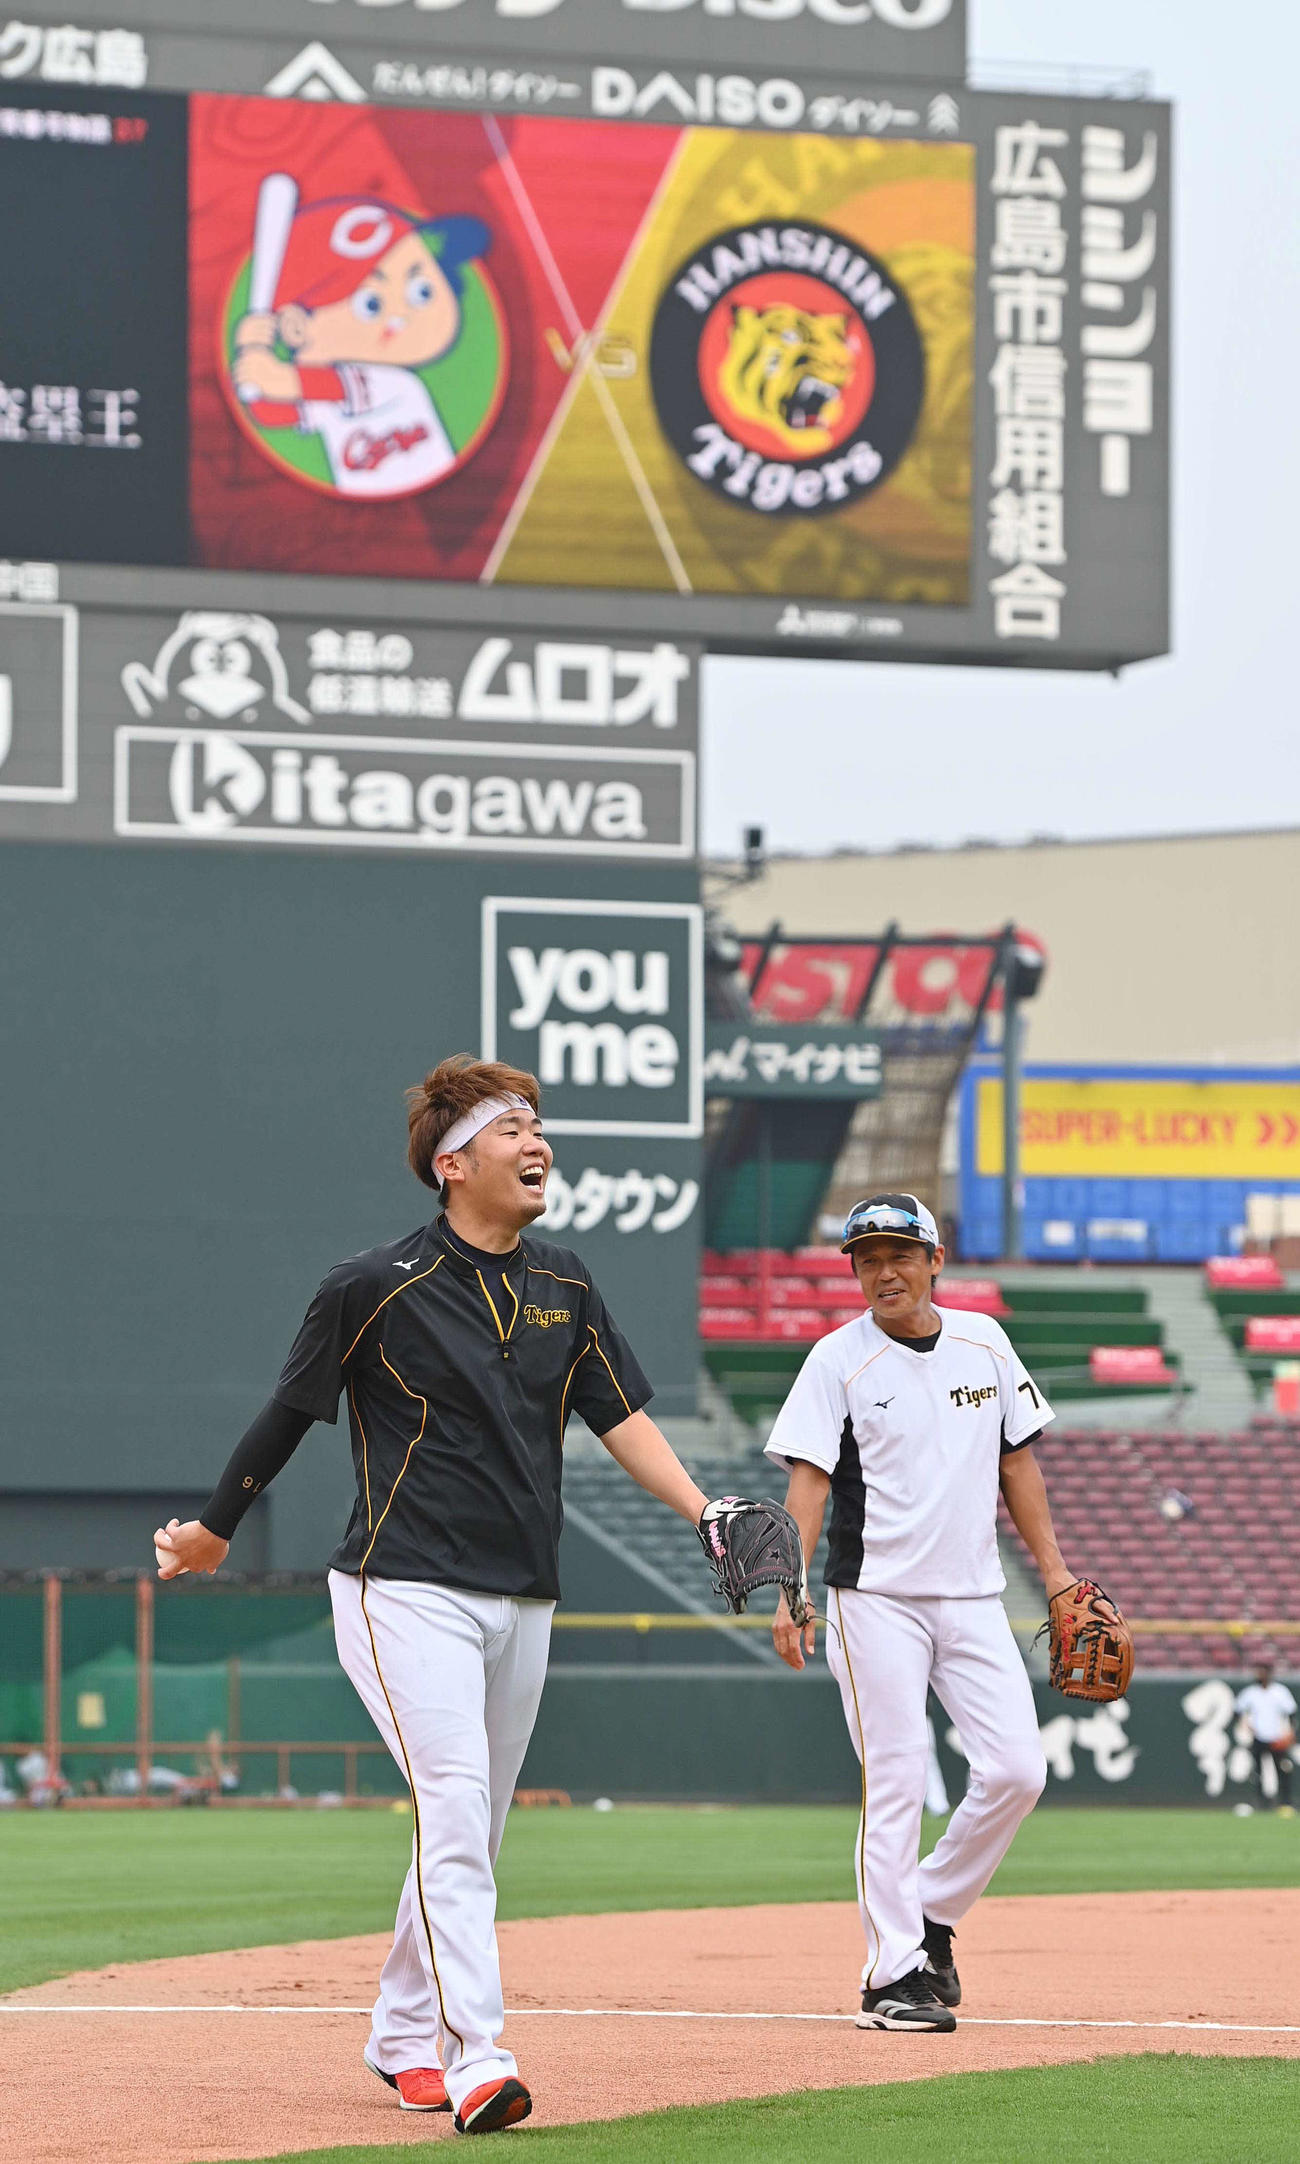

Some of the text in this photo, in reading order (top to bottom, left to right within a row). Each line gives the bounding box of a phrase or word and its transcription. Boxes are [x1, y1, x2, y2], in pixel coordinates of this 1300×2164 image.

[591, 66, 806, 128] DAISO
[675, 226, 897, 320] HANSHIN
[987, 120, 1068, 640] 広島市信用組合
[688, 423, 883, 511] Tigers
[508, 945, 670, 1030] you
[538, 1024, 680, 1088] me
[751, 1042, 882, 1085] マイナビ
[523, 1304, 572, 1328] Tigers
[949, 1385, 998, 1408] Tigers
